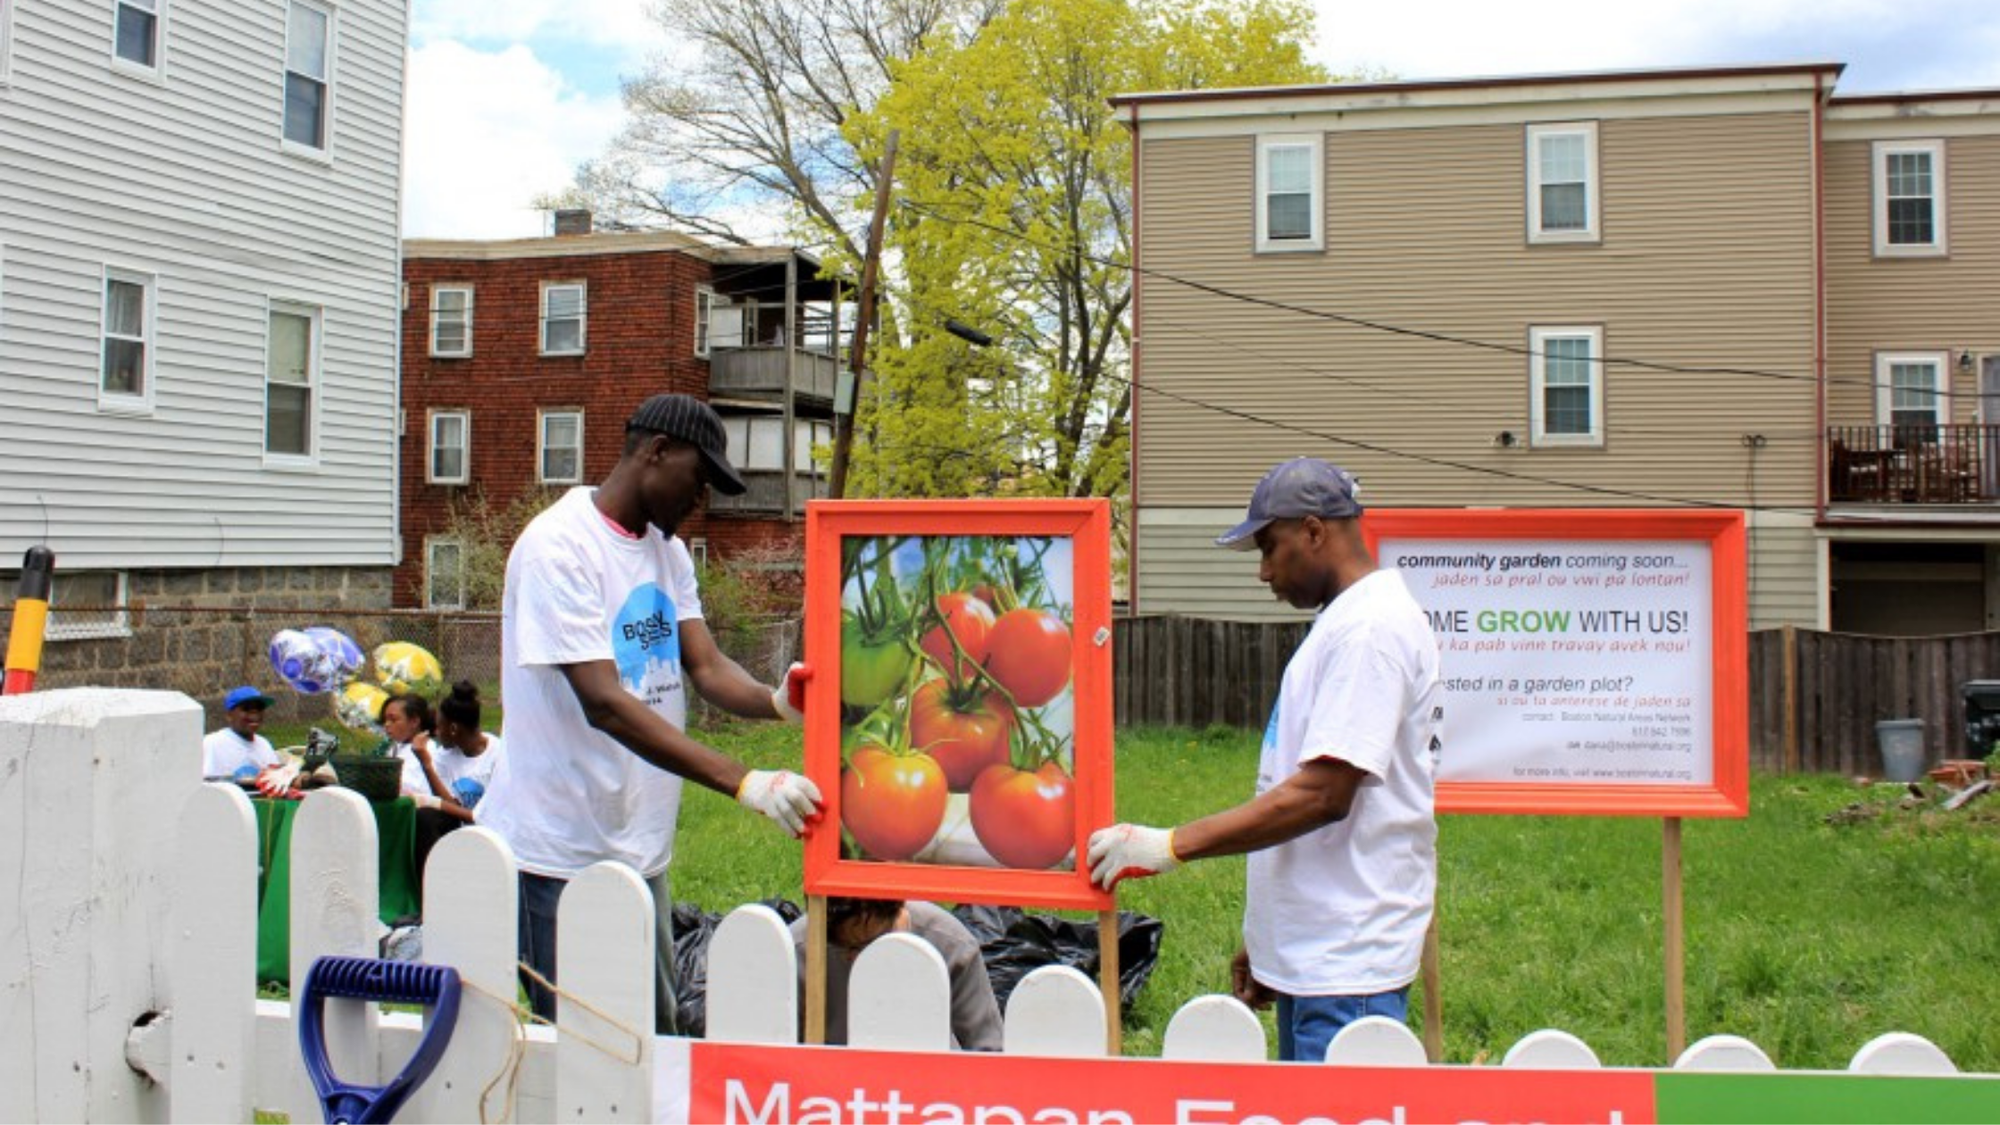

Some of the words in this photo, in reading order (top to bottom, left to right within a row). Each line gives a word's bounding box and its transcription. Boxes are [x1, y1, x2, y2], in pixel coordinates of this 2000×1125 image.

[1397, 553, 1496, 571] community
[1500, 554, 1562, 571] garden
[1566, 553, 1627, 571] coming
[1431, 572, 1478, 589] jaden
[1485, 574, 1503, 587] sa
[1508, 571, 1542, 588] pral
[1547, 574, 1567, 587] ou
[1604, 574, 1626, 588] pa
[1632, 572, 1690, 587] lontan!
[1477, 610, 1571, 633] GROW
[1579, 610, 1640, 633] WITH
[1648, 610, 1688, 633] US!
[1449, 638, 1469, 651] ka
[1475, 638, 1505, 655] pab
[1551, 639, 1605, 655] travay
[1610, 638, 1648, 652] avek
[1488, 676, 1503, 692] in
[1508, 679, 1519, 692] a
[1524, 676, 1585, 694] garden
[1590, 676, 1634, 694] plot?
